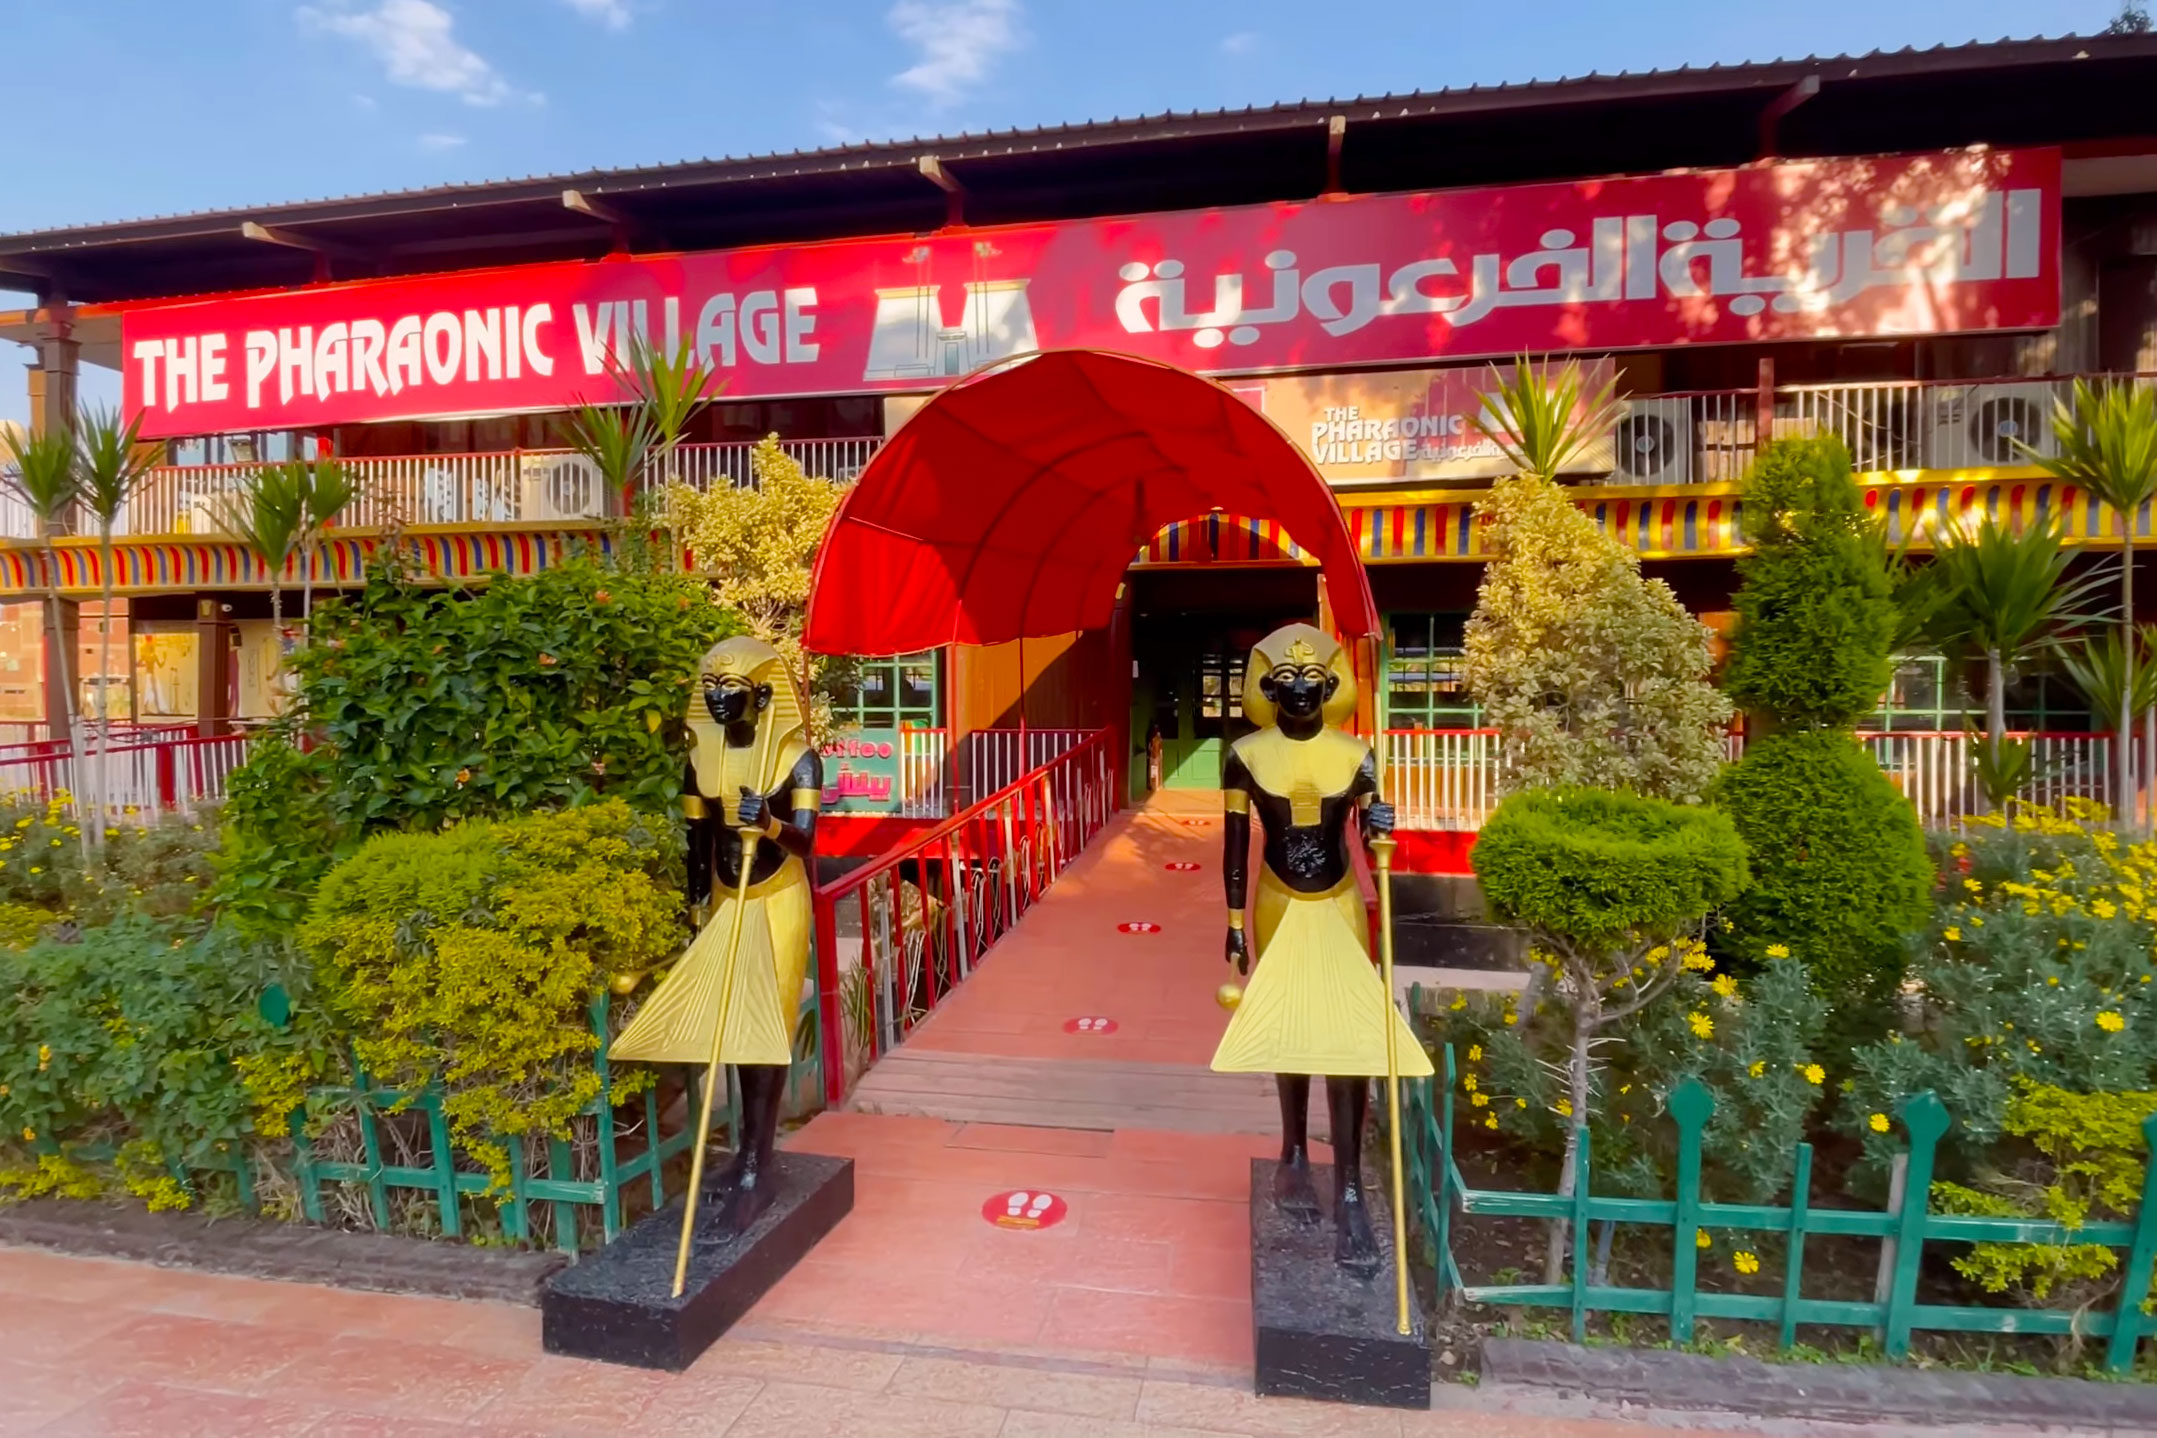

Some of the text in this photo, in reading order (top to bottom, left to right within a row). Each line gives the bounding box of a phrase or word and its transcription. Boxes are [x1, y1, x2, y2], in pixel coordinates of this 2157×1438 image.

[1115, 188, 2042, 348] القرية الفرعونية
[133, 287, 820, 413] THE PHARAONIC VILLAGE
[1312, 414, 1465, 444] PHARAONIC
[1324, 406, 1360, 422] THE
[1312, 438, 1418, 465] VILLAGE
